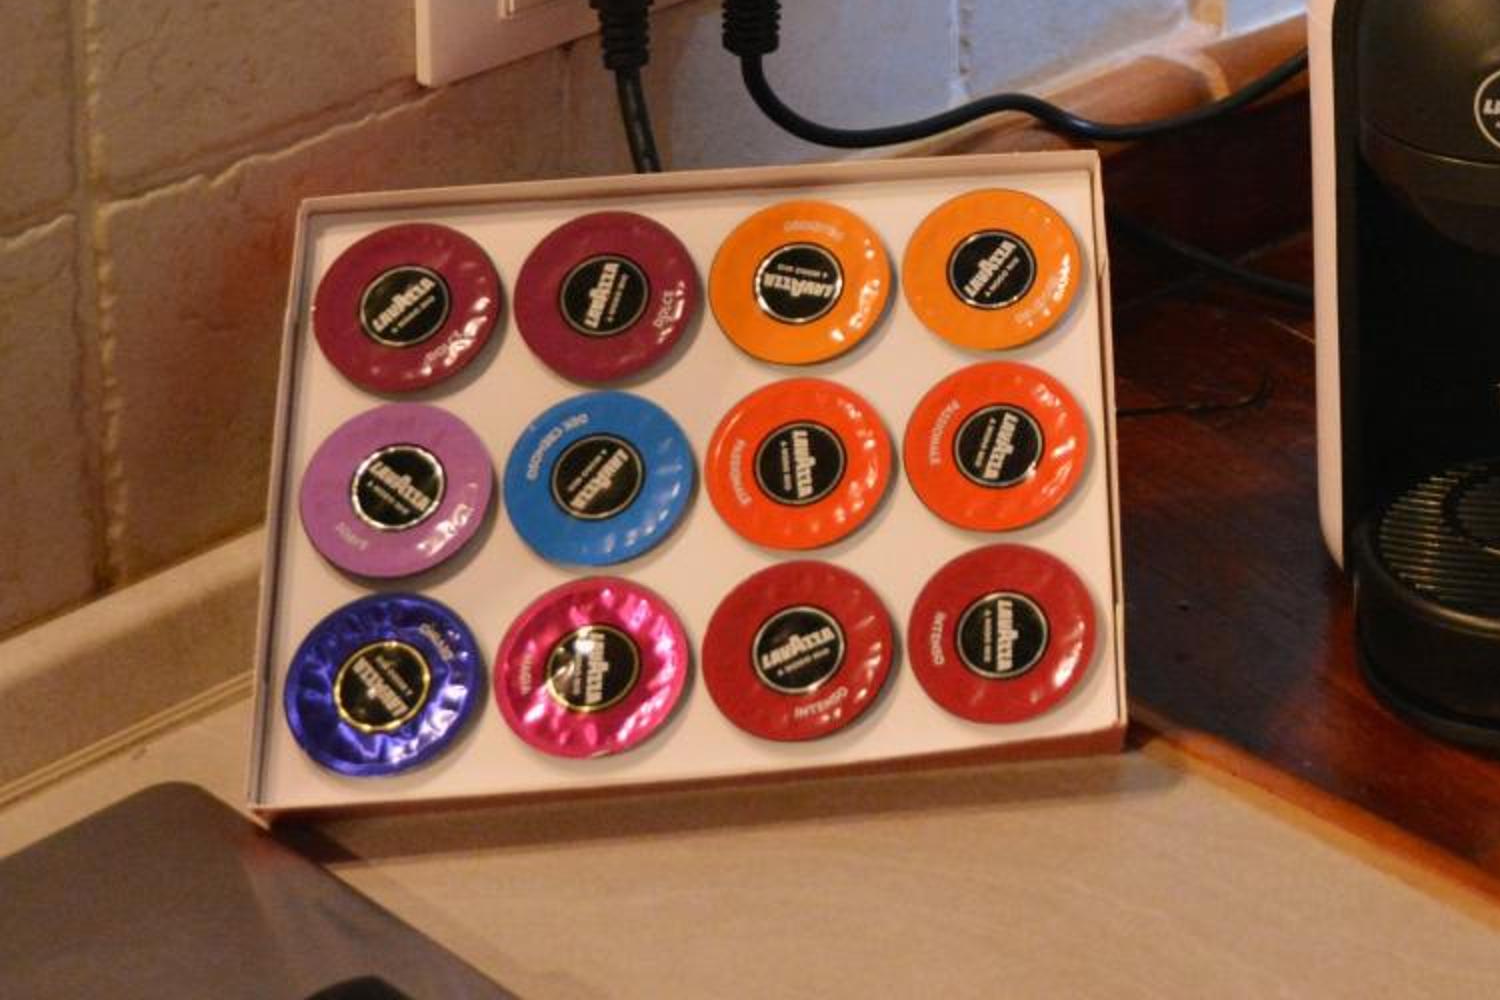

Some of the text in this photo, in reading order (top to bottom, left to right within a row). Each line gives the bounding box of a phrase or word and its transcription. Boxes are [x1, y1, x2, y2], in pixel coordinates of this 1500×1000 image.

[583, 262, 620, 329] LAVAZZA
[762, 271, 833, 299] LAVAZZA
[962, 238, 1018, 298] LAVAZZA
[370, 275, 437, 333] LAVAZZA
[791, 430, 816, 498] LAVAZZA
[982, 411, 1019, 479] LAVAZZA
[367, 459, 432, 512] LAVAZZA
[568, 447, 629, 511] LAVAZZA
[761, 625, 836, 669] LAVAZZA
[997, 599, 1018, 671] LAVAZZA
[350, 655, 409, 718] LAVAZZA
